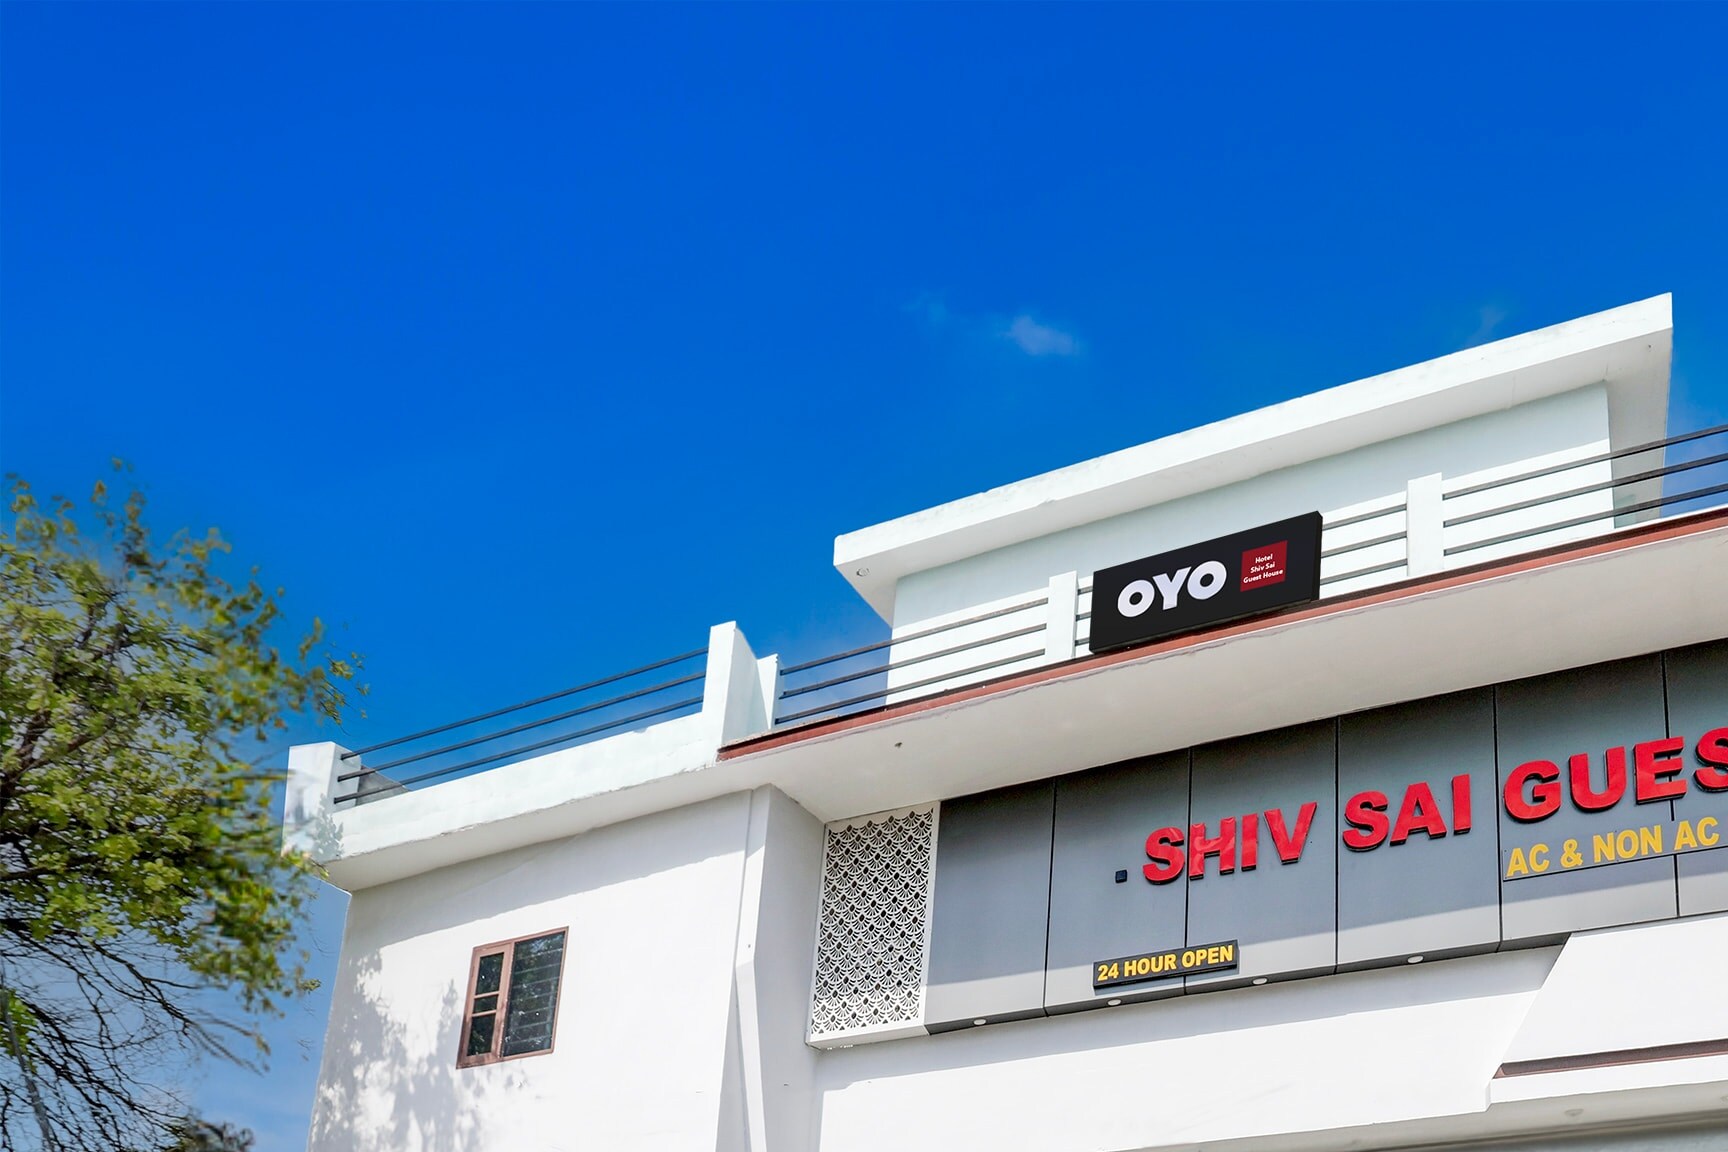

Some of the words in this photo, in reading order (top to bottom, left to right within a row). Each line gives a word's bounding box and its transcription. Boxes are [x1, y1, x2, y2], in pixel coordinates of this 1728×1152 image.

[1243, 574, 1262, 584] Guest
[1262, 569, 1284, 578] House
[1250, 565, 1265, 574] Shiv
[1265, 561, 1275, 570] Sai
[1255, 553, 1273, 563] Hotel
[1117, 560, 1227, 618] OYO
[1141, 801, 1318, 884] SHIV
[1342, 774, 1472, 850] SAI
[1506, 843, 1551, 877] AC
[1560, 838, 1583, 868] &
[1593, 825, 1663, 863] NON
[1674, 817, 1720, 851] AC
[1097, 962, 1120, 982] 24
[1123, 953, 1177, 977] HOUR
[1181, 944, 1234, 968] OPEN
